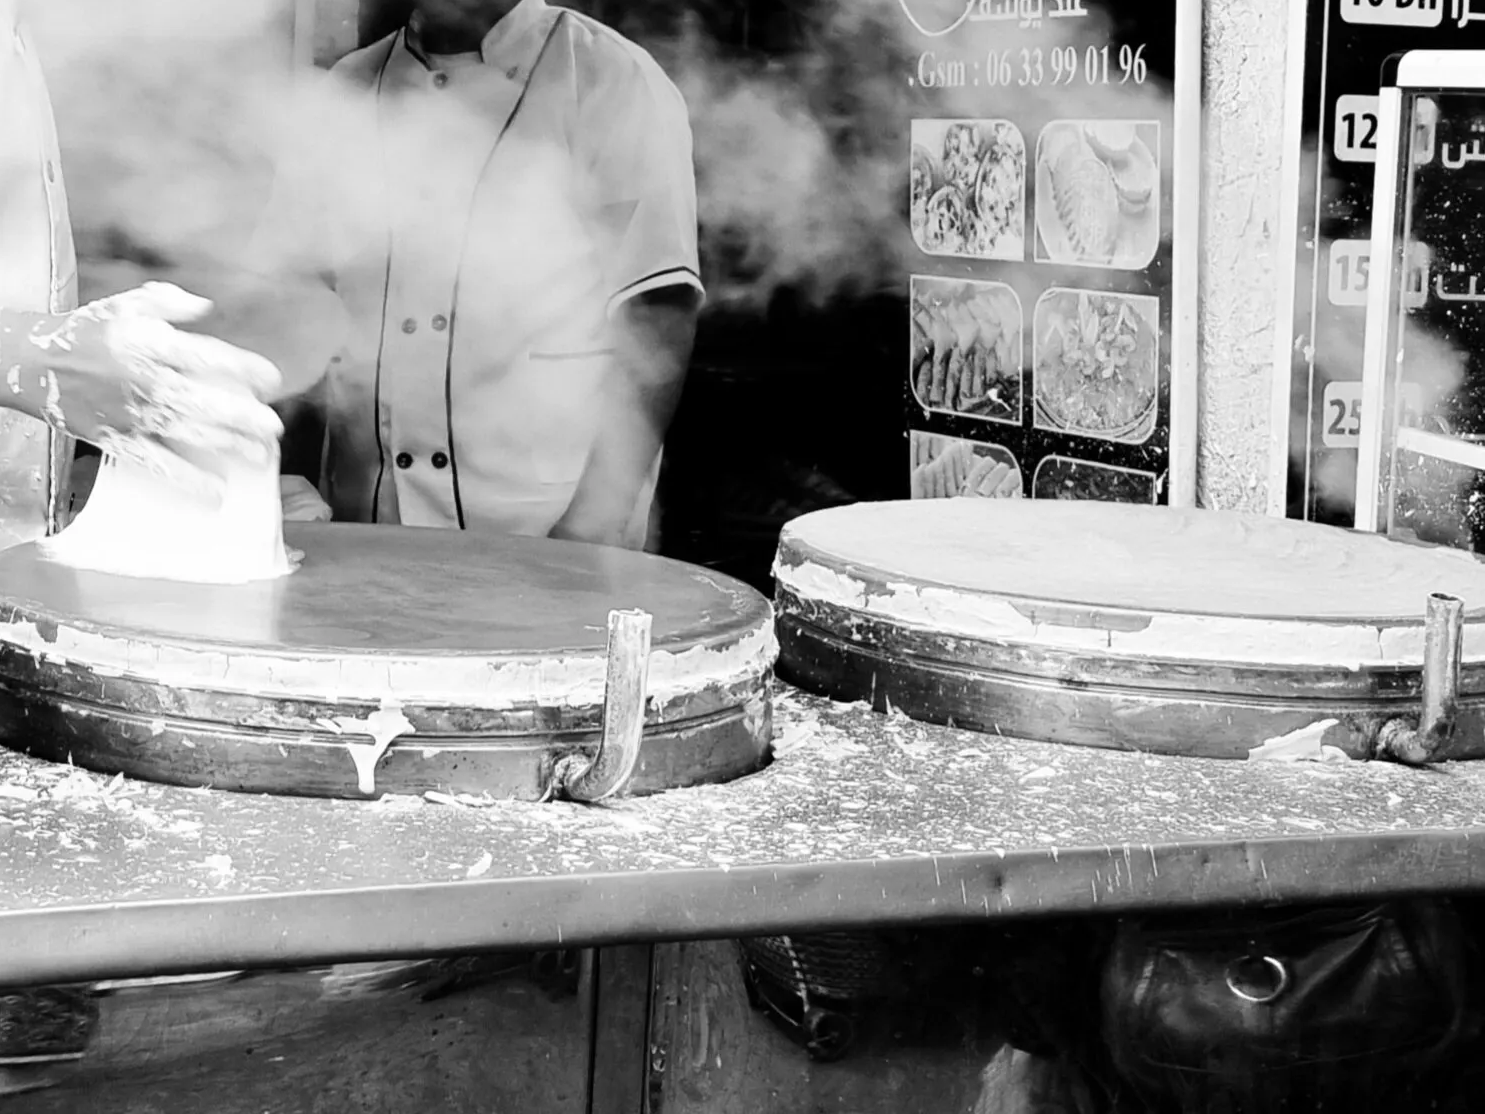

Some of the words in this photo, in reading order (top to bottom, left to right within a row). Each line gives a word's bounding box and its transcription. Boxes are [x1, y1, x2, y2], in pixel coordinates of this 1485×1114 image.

[986, 49, 1012, 87] 06
[1018, 48, 1044, 87] 33
[1050, 46, 1078, 86] 99
[1085, 45, 1110, 85] 01
[1119, 43, 1147, 84] 96
[1341, 112, 1379, 150] 12
